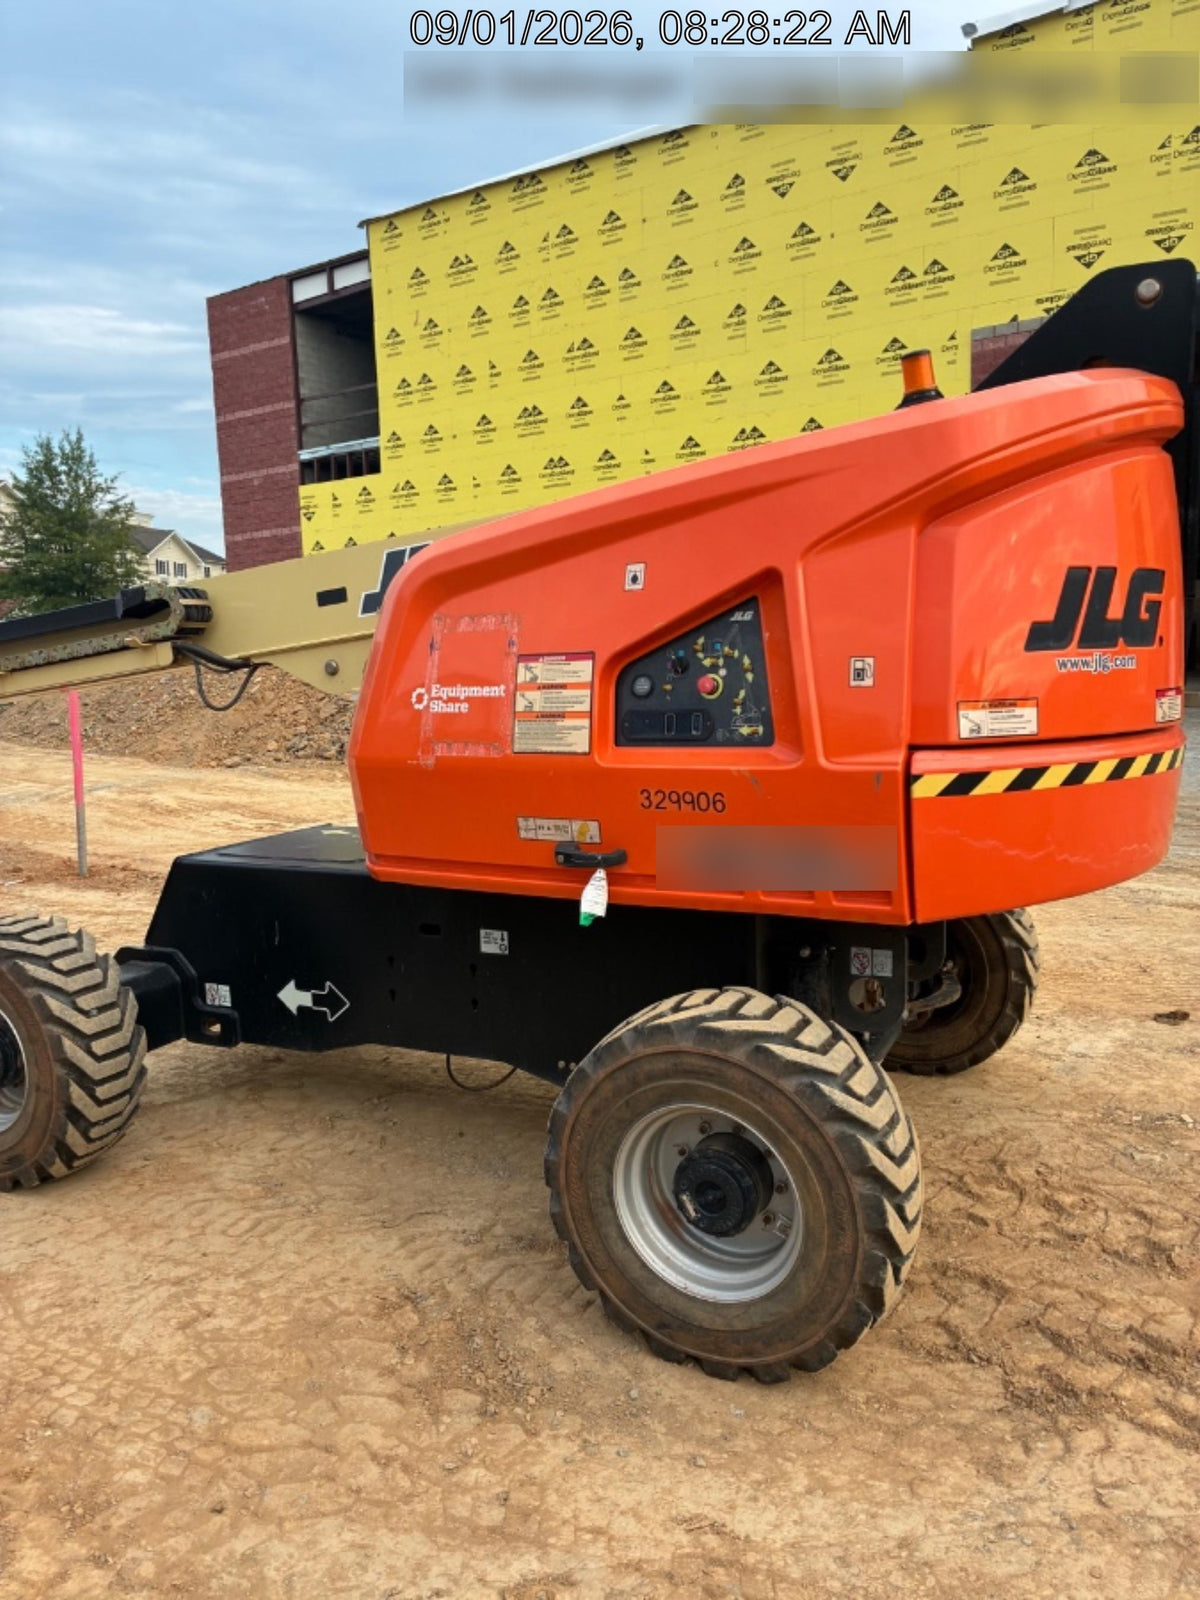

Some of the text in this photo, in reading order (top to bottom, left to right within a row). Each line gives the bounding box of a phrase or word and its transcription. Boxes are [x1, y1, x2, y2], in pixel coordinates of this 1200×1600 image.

[729, 611, 754, 621] JLG
[1024, 566, 1165, 652] JLG
[1057, 653, 1136, 672] www.jlg.com
[430, 684, 506, 699] Equipment
[430, 700, 469, 713] Share
[640, 788, 727, 814] 329906
